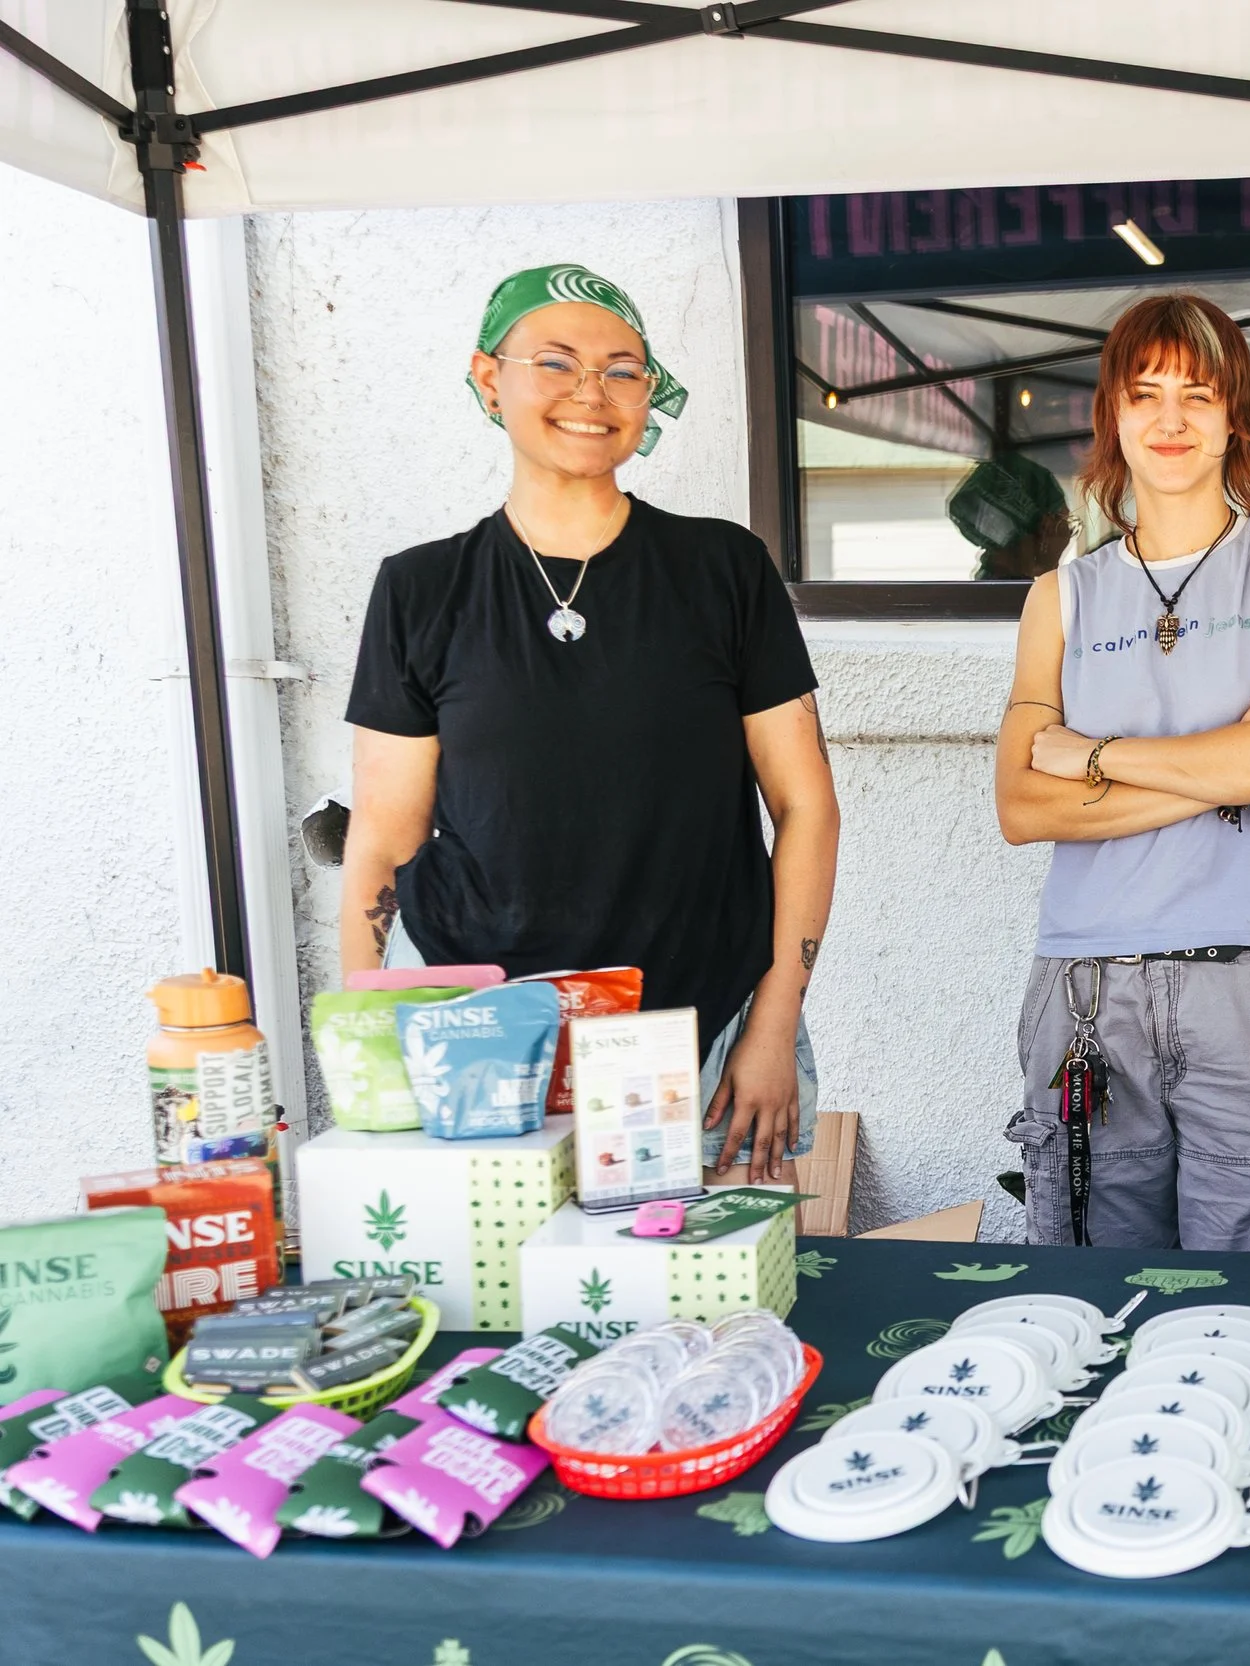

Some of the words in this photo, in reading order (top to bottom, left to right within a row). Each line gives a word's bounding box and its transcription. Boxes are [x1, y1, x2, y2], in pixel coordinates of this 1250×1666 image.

[413, 1006, 499, 1029] SINSE
[595, 1035, 640, 1049] SINSE
[1071, 1156, 1083, 1198] MOON
[167, 1211, 255, 1250] NSE
[0, 1253, 97, 1288] INSE
[333, 1260, 444, 1286] SINSE
[155, 1259, 259, 1312] IRE
[192, 1346, 299, 1362] SWADE
[309, 1343, 388, 1378] SWADE
[922, 1385, 991, 1397] SINSE
[829, 1466, 905, 1492] SINSE
[1100, 1503, 1177, 1520] SINSE
